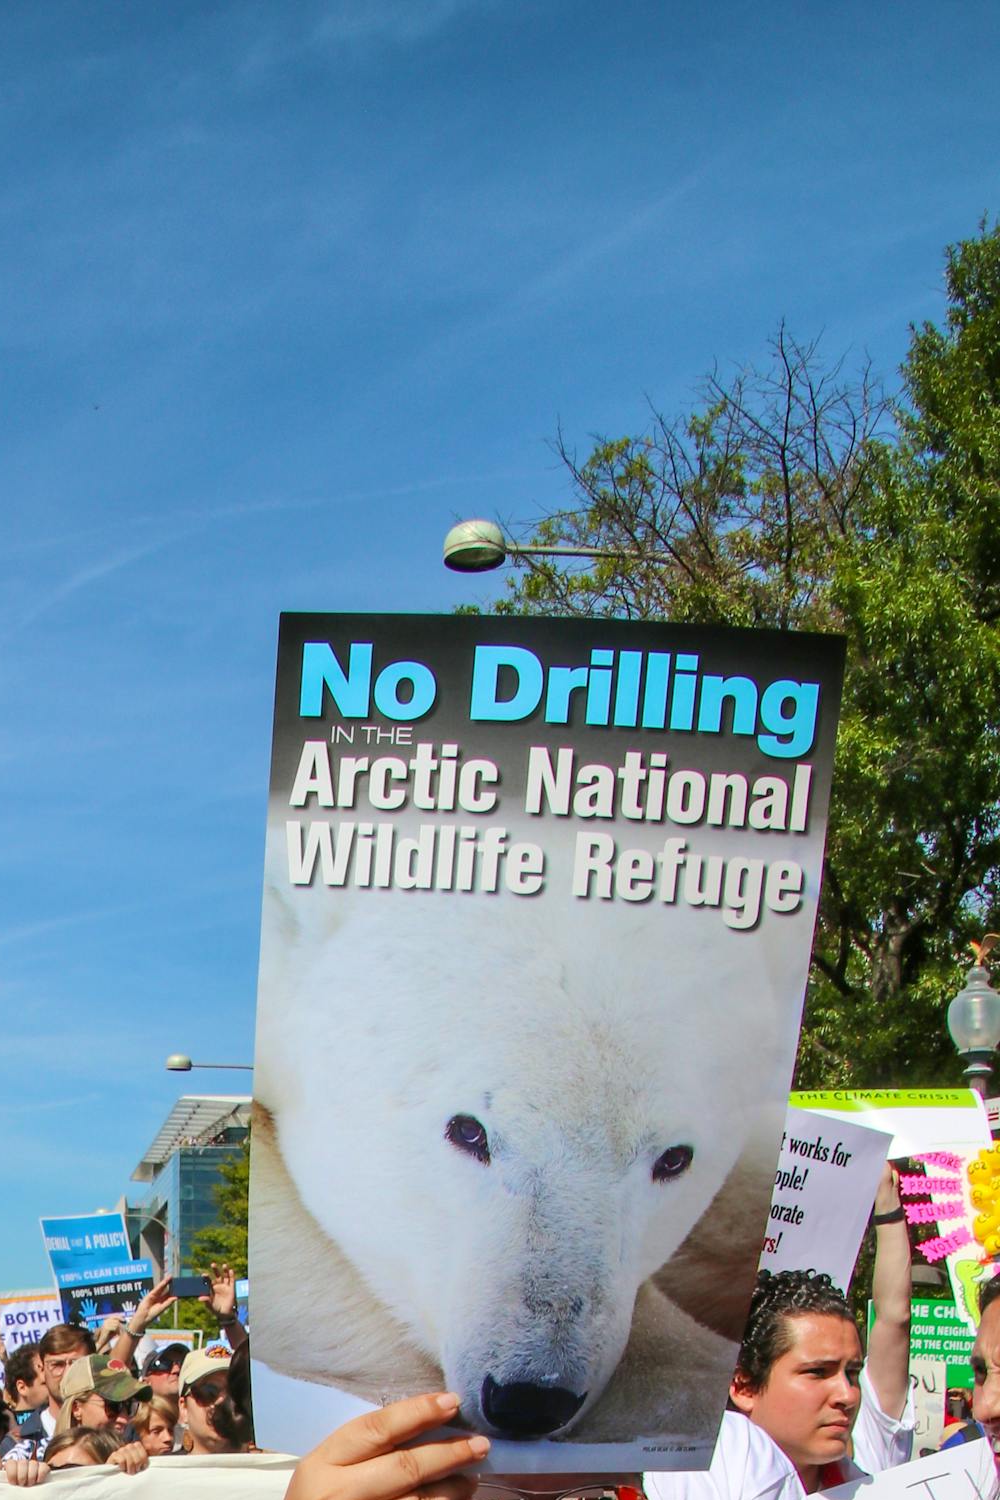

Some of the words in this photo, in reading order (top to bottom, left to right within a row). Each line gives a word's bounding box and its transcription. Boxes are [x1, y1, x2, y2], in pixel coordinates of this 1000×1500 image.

[300, 642, 437, 720] No
[470, 644, 820, 758] Drilling
[331, 725, 354, 744] IN
[361, 726, 413, 745] THE
[289, 740, 498, 812] Arctic
[524, 746, 813, 832] National
[285, 820, 545, 894] Wildlife
[572, 830, 804, 930] Refuge
[834, 1091, 902, 1101] CLIMATE
[907, 1092, 960, 1101] CRISIS
[789, 1136, 829, 1164] works
[831, 1142, 852, 1168] for
[926, 1153, 960, 1169] STORE
[775, 1165, 809, 1192] ople!
[909, 1181, 958, 1191] PROTECT
[770, 1203, 805, 1226] orate
[918, 1204, 955, 1218] FUND
[84, 1235, 92, 1250] A
[93, 1231, 125, 1250] POLICY
[929, 1235, 962, 1254] VOTE
[83, 1268, 112, 1280] CLEAN
[113, 1264, 149, 1276] ENERGY
[71, 1288, 93, 1299] 100%
[93, 1284, 116, 1296] HERE
[117, 1283, 133, 1293] FOR
[134, 1281, 143, 1291] IT
[4, 1309, 50, 1326] BOTH
[910, 1304, 929, 1318] HE
[910, 1340, 922, 1350] OR
[924, 1339, 941, 1350] THE
[946, 1354, 971, 1366] CREA
